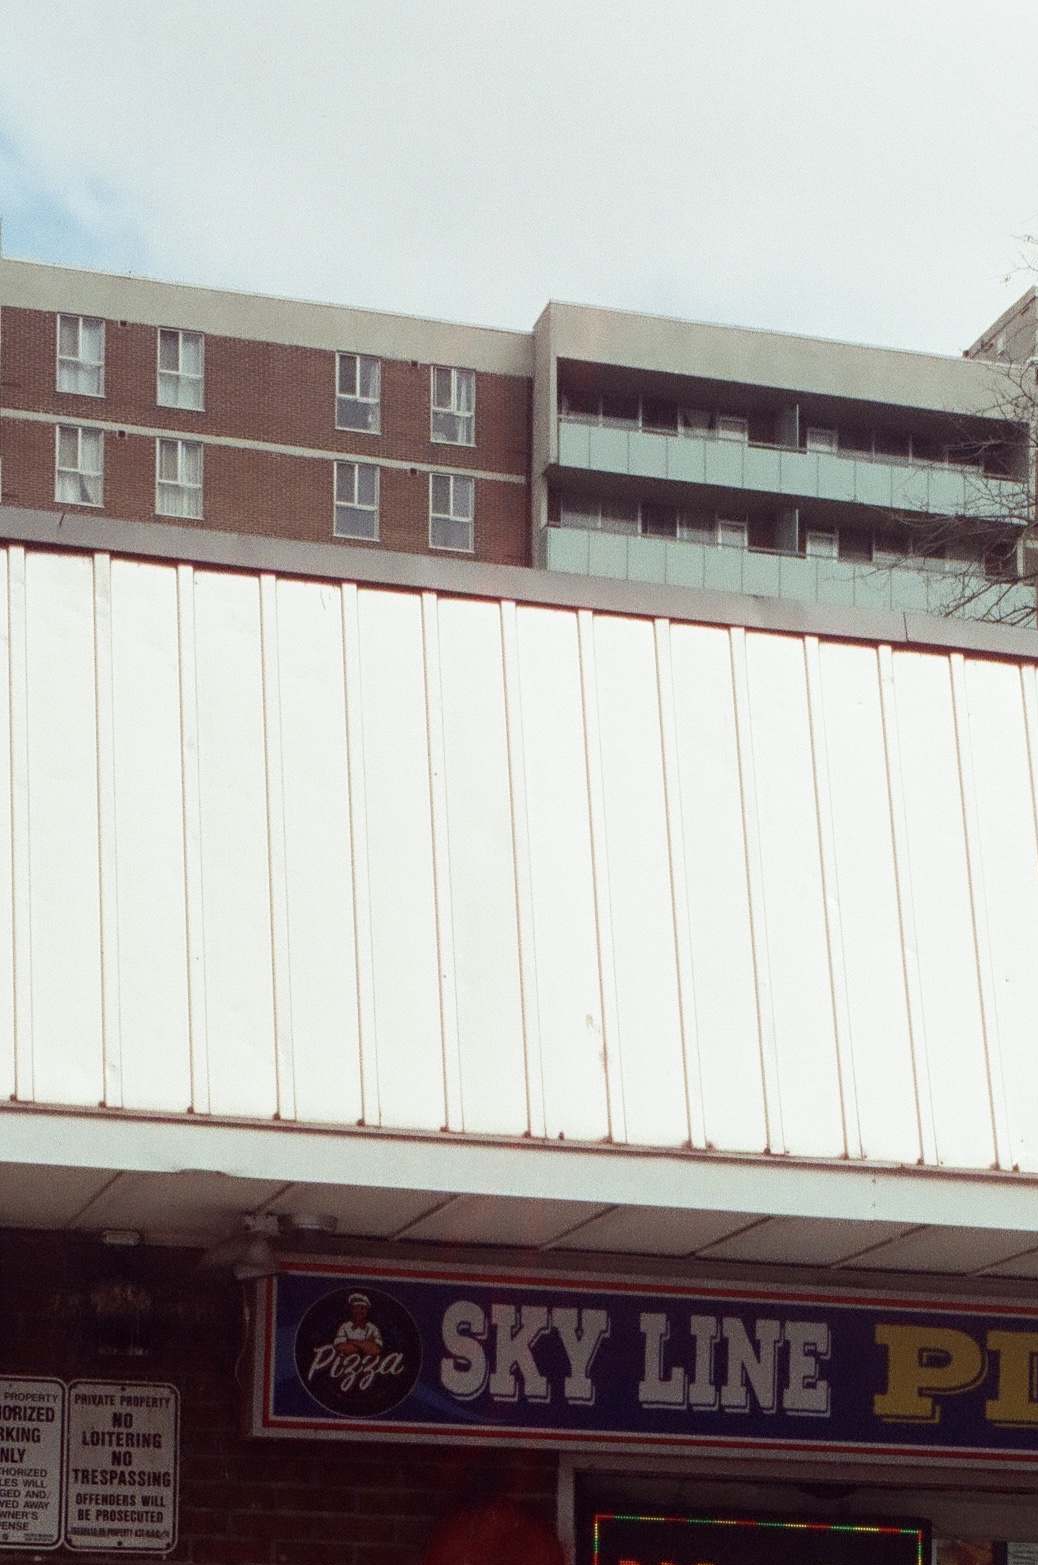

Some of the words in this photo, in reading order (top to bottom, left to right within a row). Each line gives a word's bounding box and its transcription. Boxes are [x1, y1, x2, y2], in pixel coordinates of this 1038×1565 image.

[440, 1300, 610, 1404] SKY
[638, 1311, 831, 1417] LINE
[307, 1344, 405, 1392] Pizza
[4, 1391, 58, 1403] PROPERTY
[75, 1394, 116, 1406] PRIVATE
[120, 1395, 171, 1408] PROPERTY
[112, 1412, 133, 1428] NO
[82, 1431, 162, 1448] LOITERING
[111, 1451, 133, 1466] NO
[22, 1479, 47, 1488] WILL
[72, 1469, 171, 1487] TRESPASSING
[23, 1501, 50, 1510] AWAY
[75, 1493, 136, 1507] OFFENDERS
[141, 1495, 166, 1507] WILL
[78, 1509, 91, 1521] BE
[95, 1510, 163, 1523] PROSECUTED
